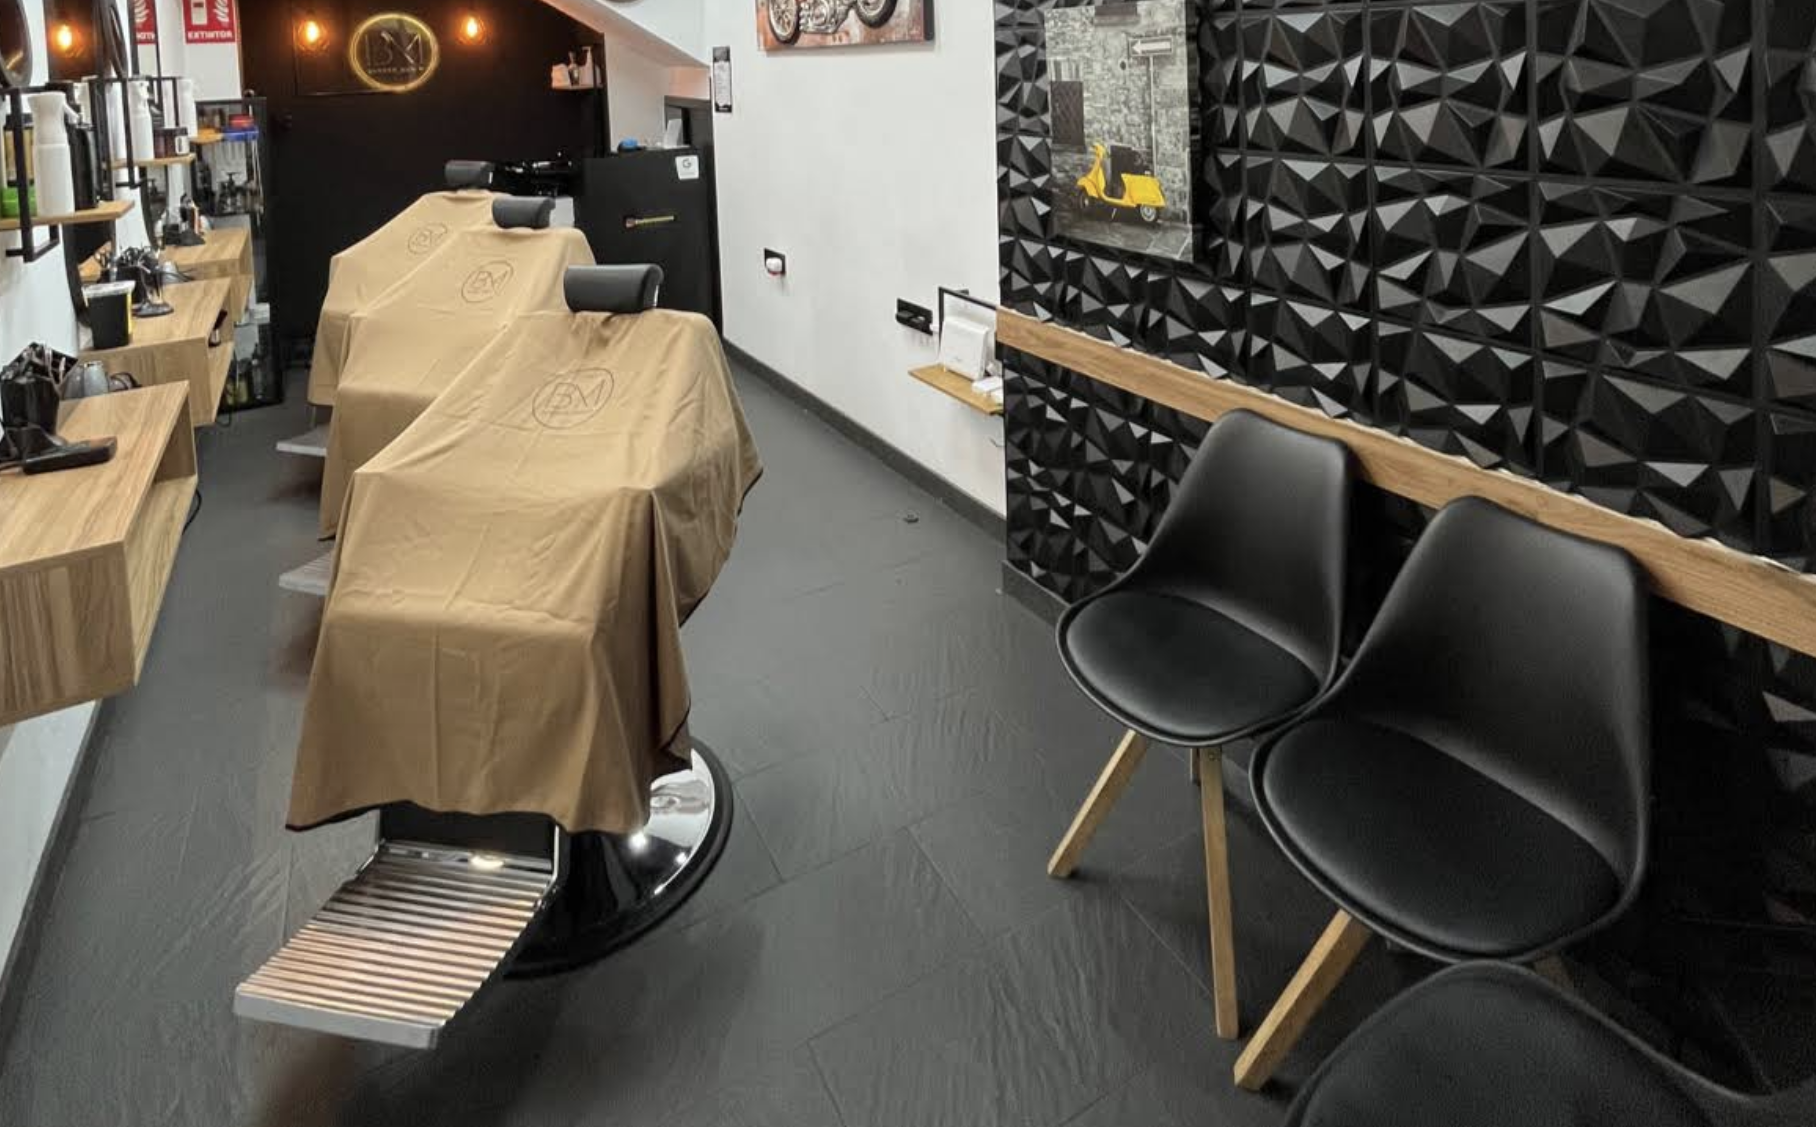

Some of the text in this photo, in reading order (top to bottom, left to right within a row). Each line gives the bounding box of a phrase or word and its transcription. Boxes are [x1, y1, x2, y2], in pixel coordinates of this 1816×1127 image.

[187, 30, 233, 40] EXTINTOR
[682, 157, 692, 168] G
[544, 378, 606, 410] BM
